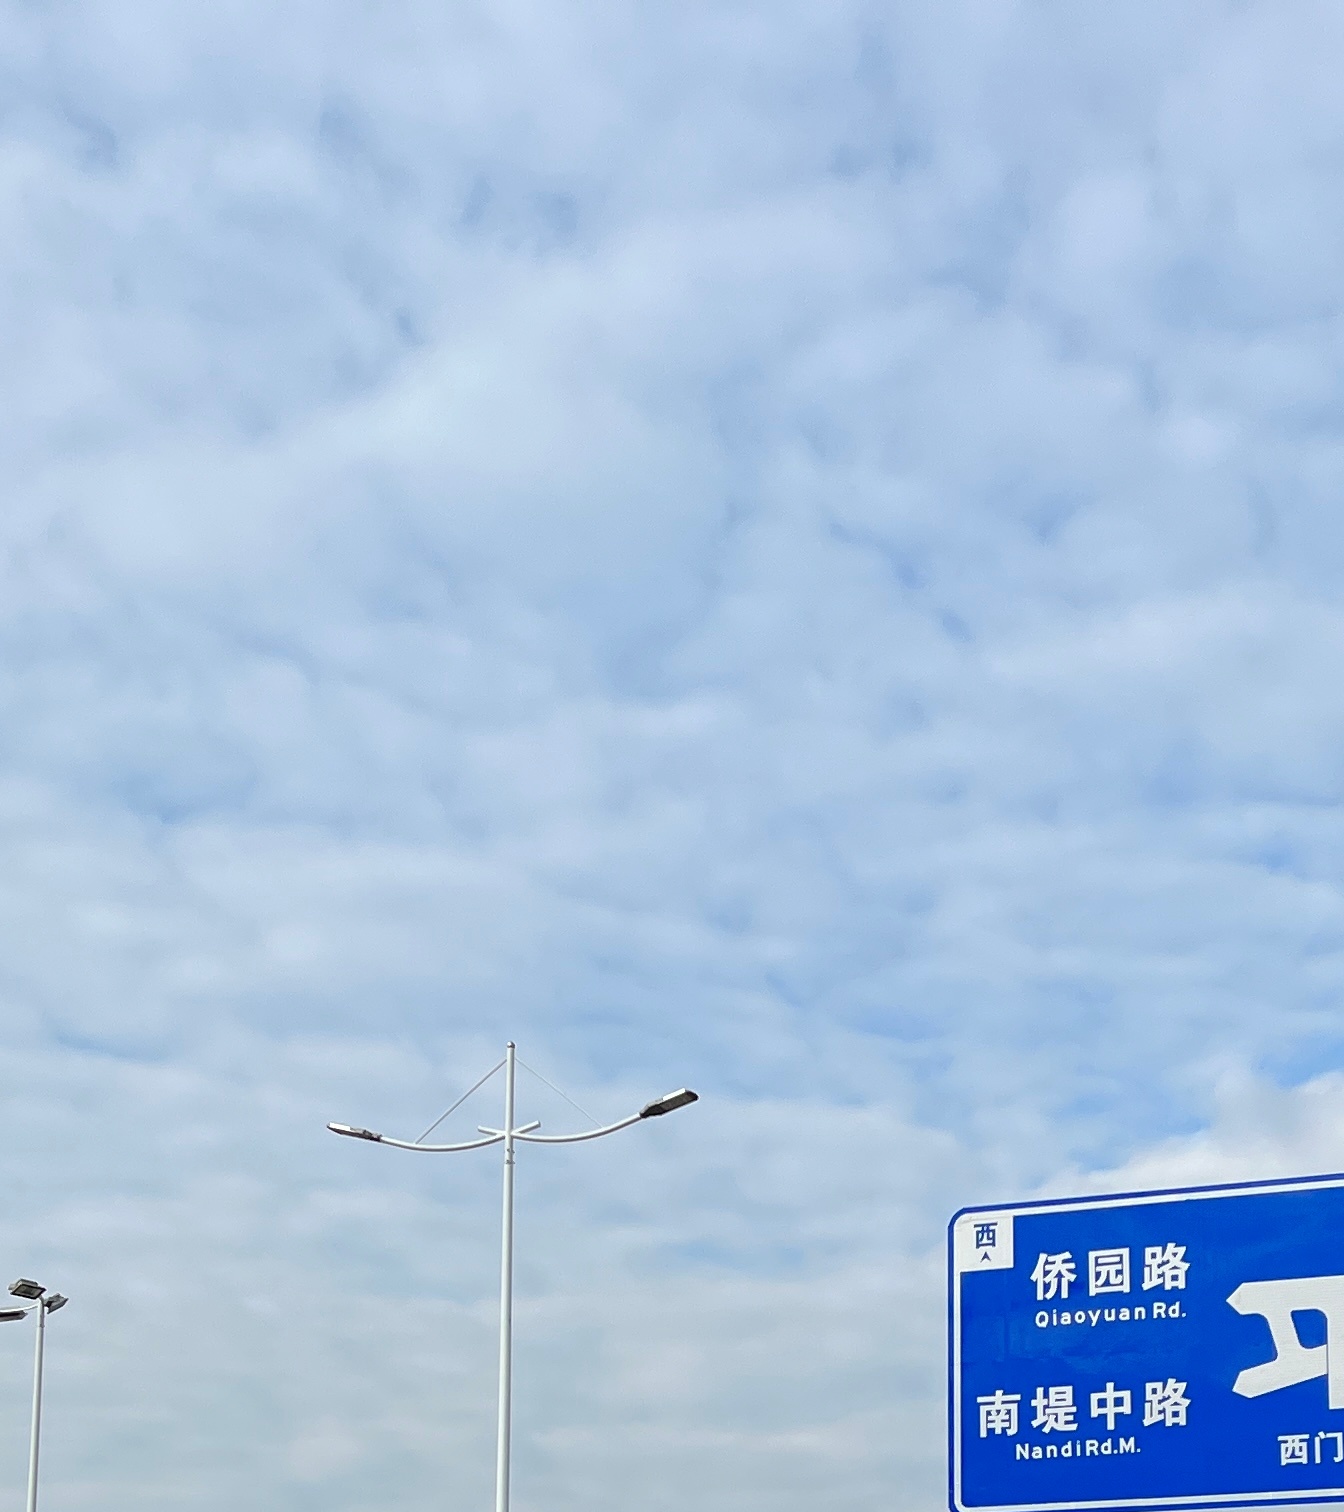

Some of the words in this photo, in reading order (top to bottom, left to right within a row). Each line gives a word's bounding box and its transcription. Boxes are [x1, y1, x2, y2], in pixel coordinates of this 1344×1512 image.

[973, 1221, 999, 1250] 西
[1029, 1242, 1191, 1301] 侨园路
[1034, 1305, 1147, 1329] Qiaoyuan
[1152, 1301, 1188, 1320] Rd.
[976, 1377, 1192, 1439] 南堤中路
